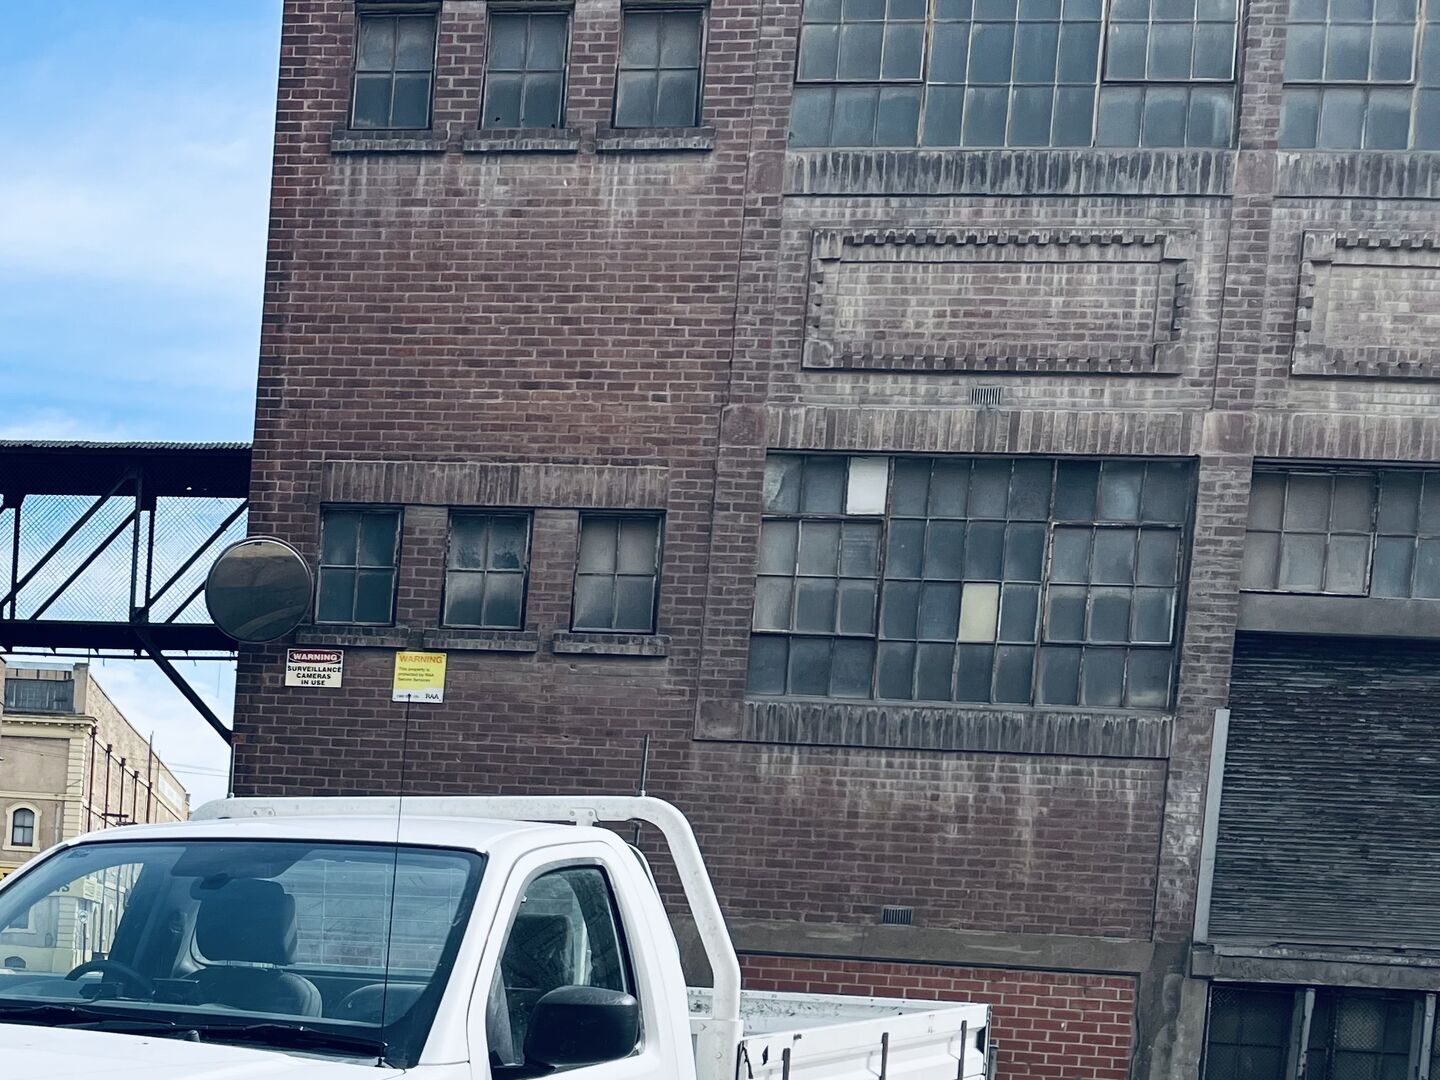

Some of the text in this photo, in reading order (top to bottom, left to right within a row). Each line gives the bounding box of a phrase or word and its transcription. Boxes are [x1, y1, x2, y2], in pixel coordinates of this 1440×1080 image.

[293, 653, 338, 661] WARNING
[399, 655, 443, 664] WARNING
[287, 665, 341, 673] SURVEILLANCE
